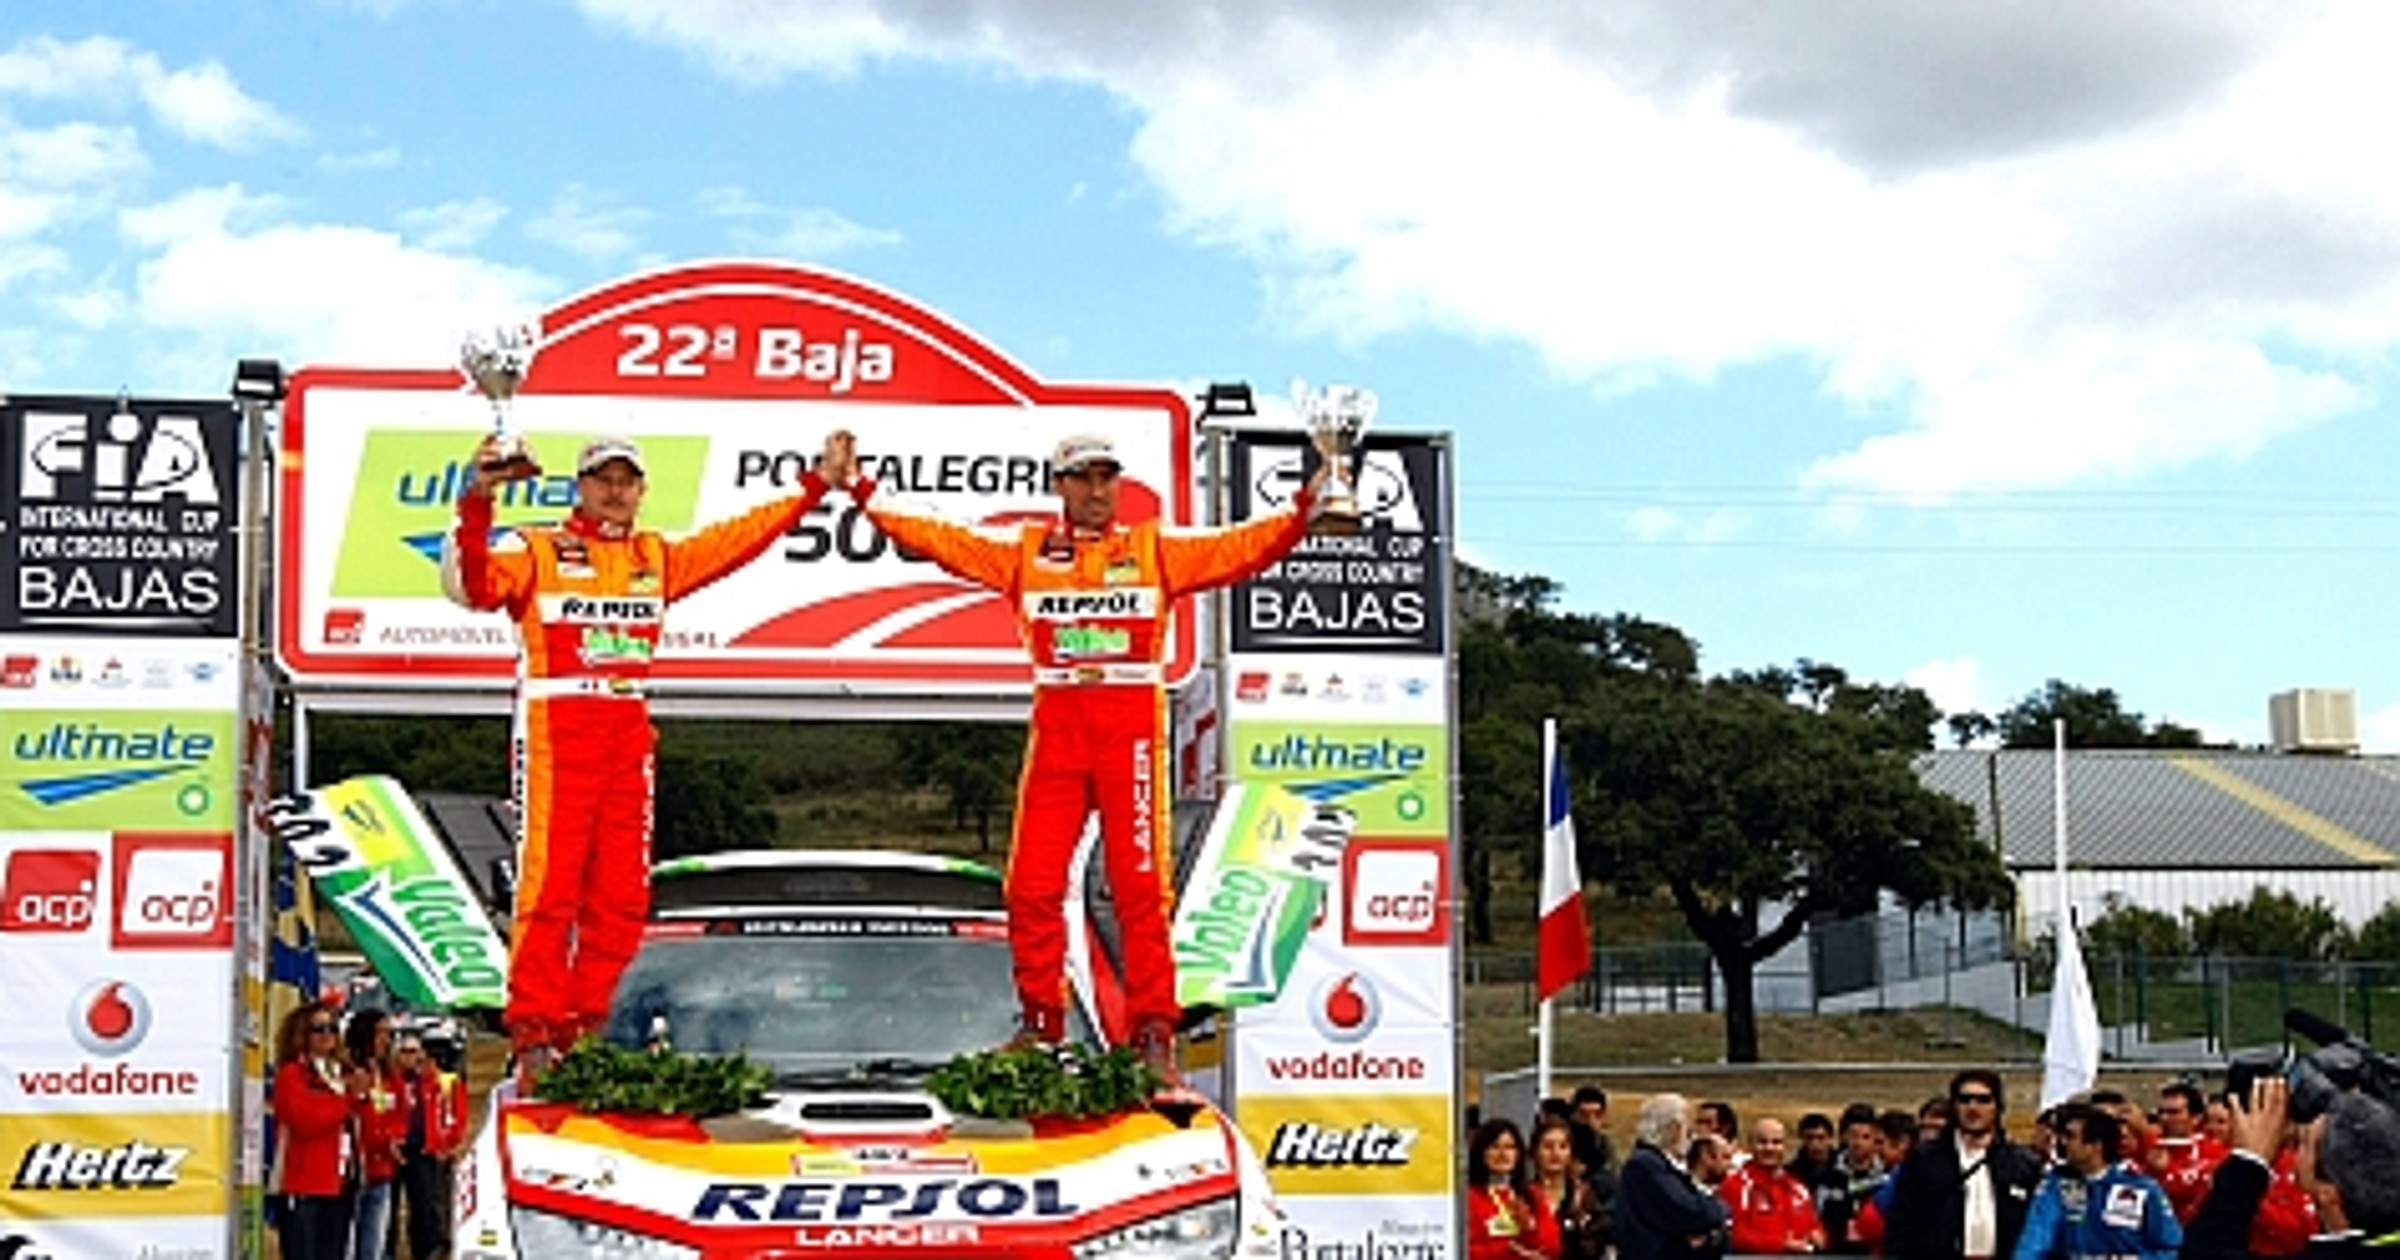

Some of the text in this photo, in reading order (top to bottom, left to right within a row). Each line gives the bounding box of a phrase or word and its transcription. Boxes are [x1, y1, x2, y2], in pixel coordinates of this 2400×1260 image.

[755, 327, 894, 392] Baja
[20, 506, 219, 533] INTERNATIONAL CUP
[785, 500, 928, 562] 50
[20, 536, 219, 561] FOR CROSS COUNTRY
[1387, 536, 1424, 558] CUP
[20, 566, 219, 613] BAJAS
[1250, 589, 1425, 632] BAJAS
[15, 723, 214, 760] ultimate
[1250, 734, 1426, 770] ultimate
[1134, 738, 1151, 871] LANCER
[390, 879, 503, 988] Valeo
[1175, 870, 1270, 974] Valeo
[18, 1063, 198, 1094] vodafone
[1266, 1050, 1425, 1079] vodafone
[10, 1139, 192, 1190] Hertz
[1265, 1122, 1421, 1168] Hertz
[692, 1179, 1080, 1221] REPSOL
[796, 1225, 981, 1247] LANCER
